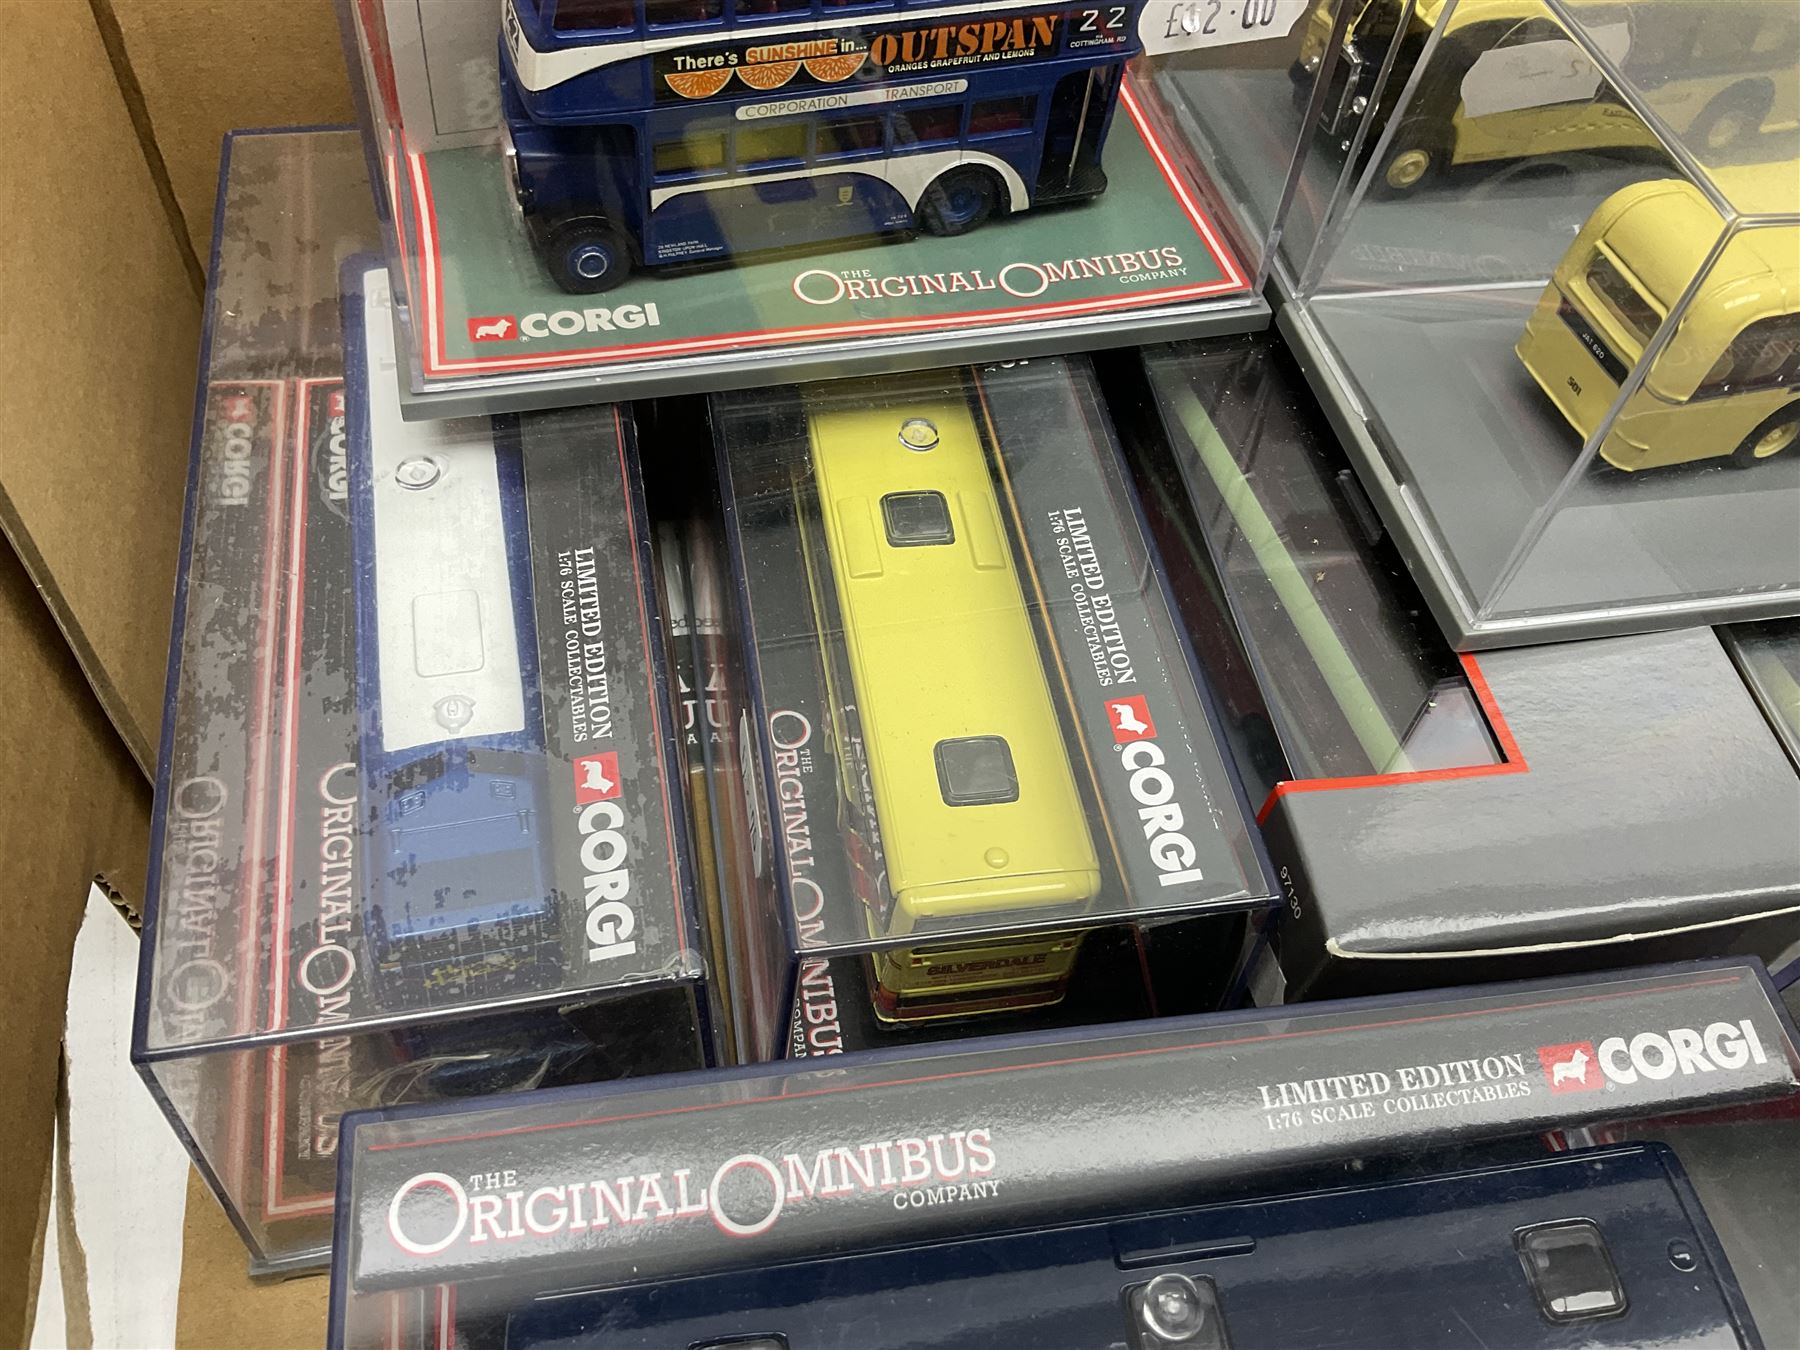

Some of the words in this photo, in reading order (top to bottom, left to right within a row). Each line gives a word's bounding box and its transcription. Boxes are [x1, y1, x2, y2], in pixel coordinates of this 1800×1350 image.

[673, 52, 738, 70] There's
[745, 39, 838, 64] SUNSHINE
[870, 15, 1058, 66] OUTSPAN
[888, 61, 928, 73] ORANGES
[930, 54, 981, 68] GRAPEFRUIT
[983, 52, 1000, 62] AND
[1001, 48, 1035, 59] LEMONS
[1070, 37, 1114, 48] COTTINGHAM
[745, 95, 848, 118] CORPORATION
[885, 81, 959, 100] TRANSPORT
[793, 269, 996, 304] ORIGINAL
[998, 247, 1183, 297] OMNIBUS
[841, 269, 872, 280] THE
[1119, 267, 1189, 284] COMPANY
[520, 303, 660, 338] CORGI
[1047, 509, 1066, 534] 1:76
[558, 550, 573, 583] 1:76
[1055, 537, 1079, 580] SCALE
[560, 586, 577, 627] SCALE
[574, 546, 599, 636] LIMITED
[1063, 507, 1104, 590] LIMITED
[1091, 592, 1136, 685] EDITION
[1070, 582, 1113, 688] COLLECTABLES
[565, 630, 588, 744] COLLECTABLES
[585, 639, 613, 739] EDITION
[800, 748, 813, 773] THE
[770, 708, 816, 880] ORIGINAL
[1121, 740, 1203, 886] CORGI
[318, 763, 357, 945] ORIGINAL
[578, 801, 636, 962] CORGI
[1280, 865, 1302, 919] 97130
[1597, 1019, 1768, 1084] CORGI
[1257, 1068, 1391, 1110] LIMITED
[1396, 1053, 1525, 1093] EDITION
[1266, 1111, 1302, 1131] 1:76
[1311, 1100, 1375, 1125] SCALE
[1383, 1080, 1531, 1114] COLLECTABLES
[387, 1169, 707, 1256] ORIGINAL
[708, 1128, 998, 1238] OMNIBUS
[470, 1169, 516, 1189] THE
[892, 1180, 1000, 1211] COMPANY
